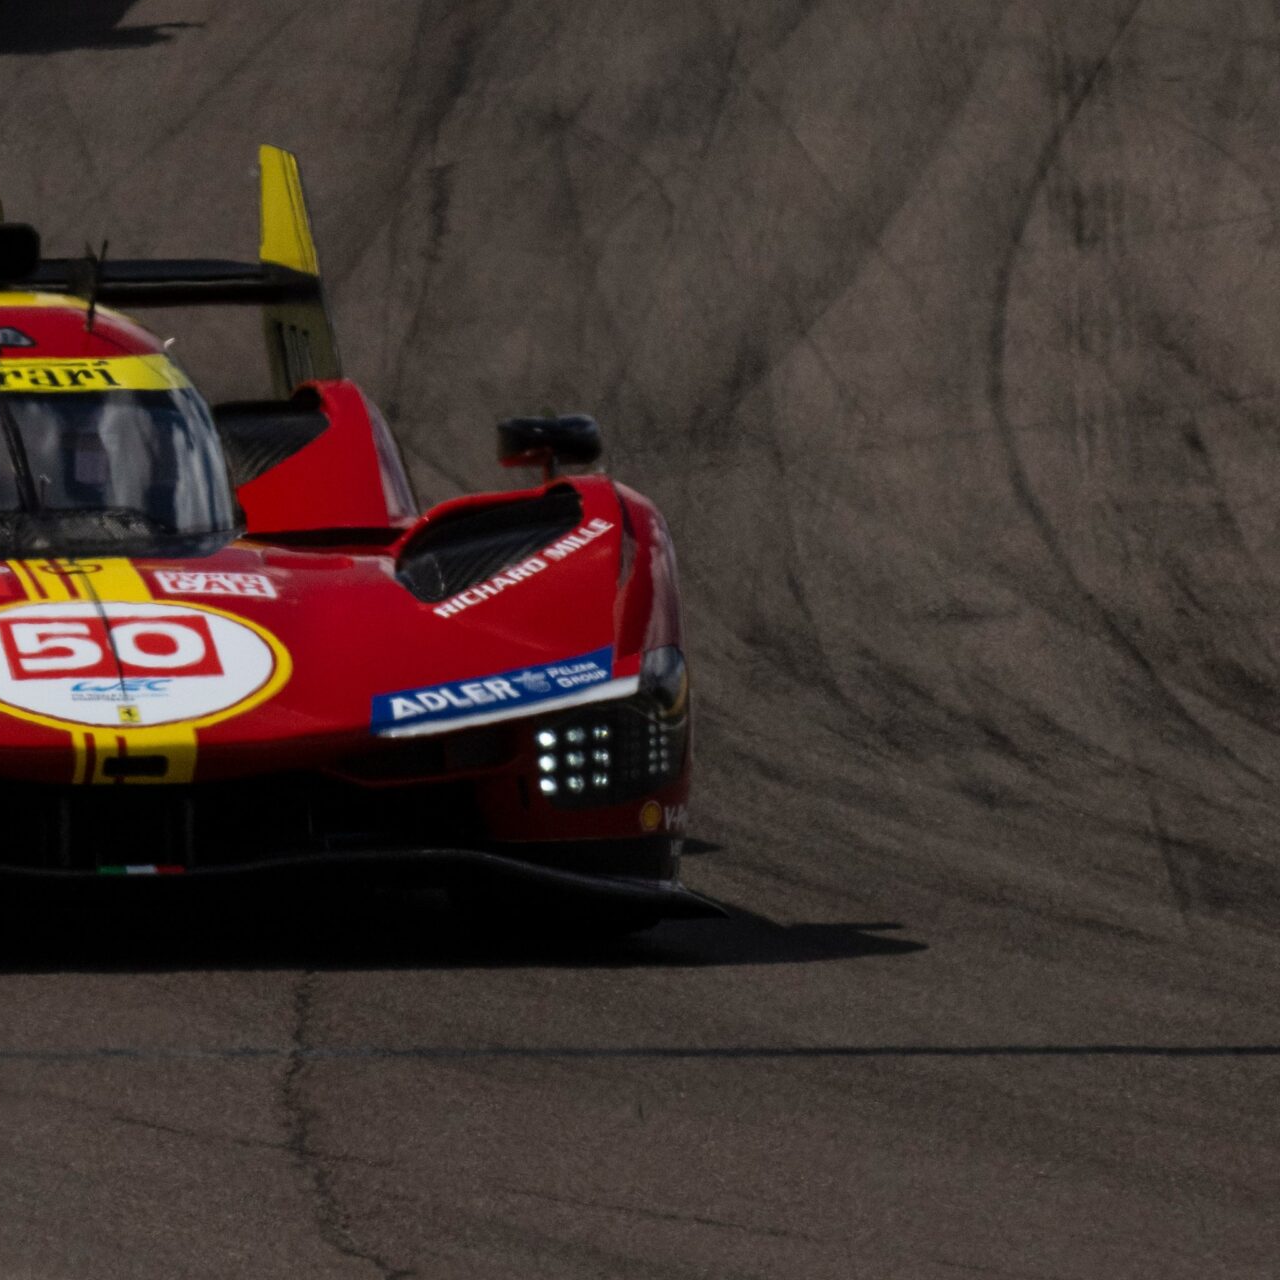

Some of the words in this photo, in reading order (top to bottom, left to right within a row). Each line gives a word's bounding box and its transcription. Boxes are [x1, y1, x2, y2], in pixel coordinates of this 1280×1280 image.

[433, 557, 549, 618] RICHARD
[542, 517, 615, 562] MILLE
[9, 621, 207, 671] 50
[389, 676, 521, 721] ADLER
